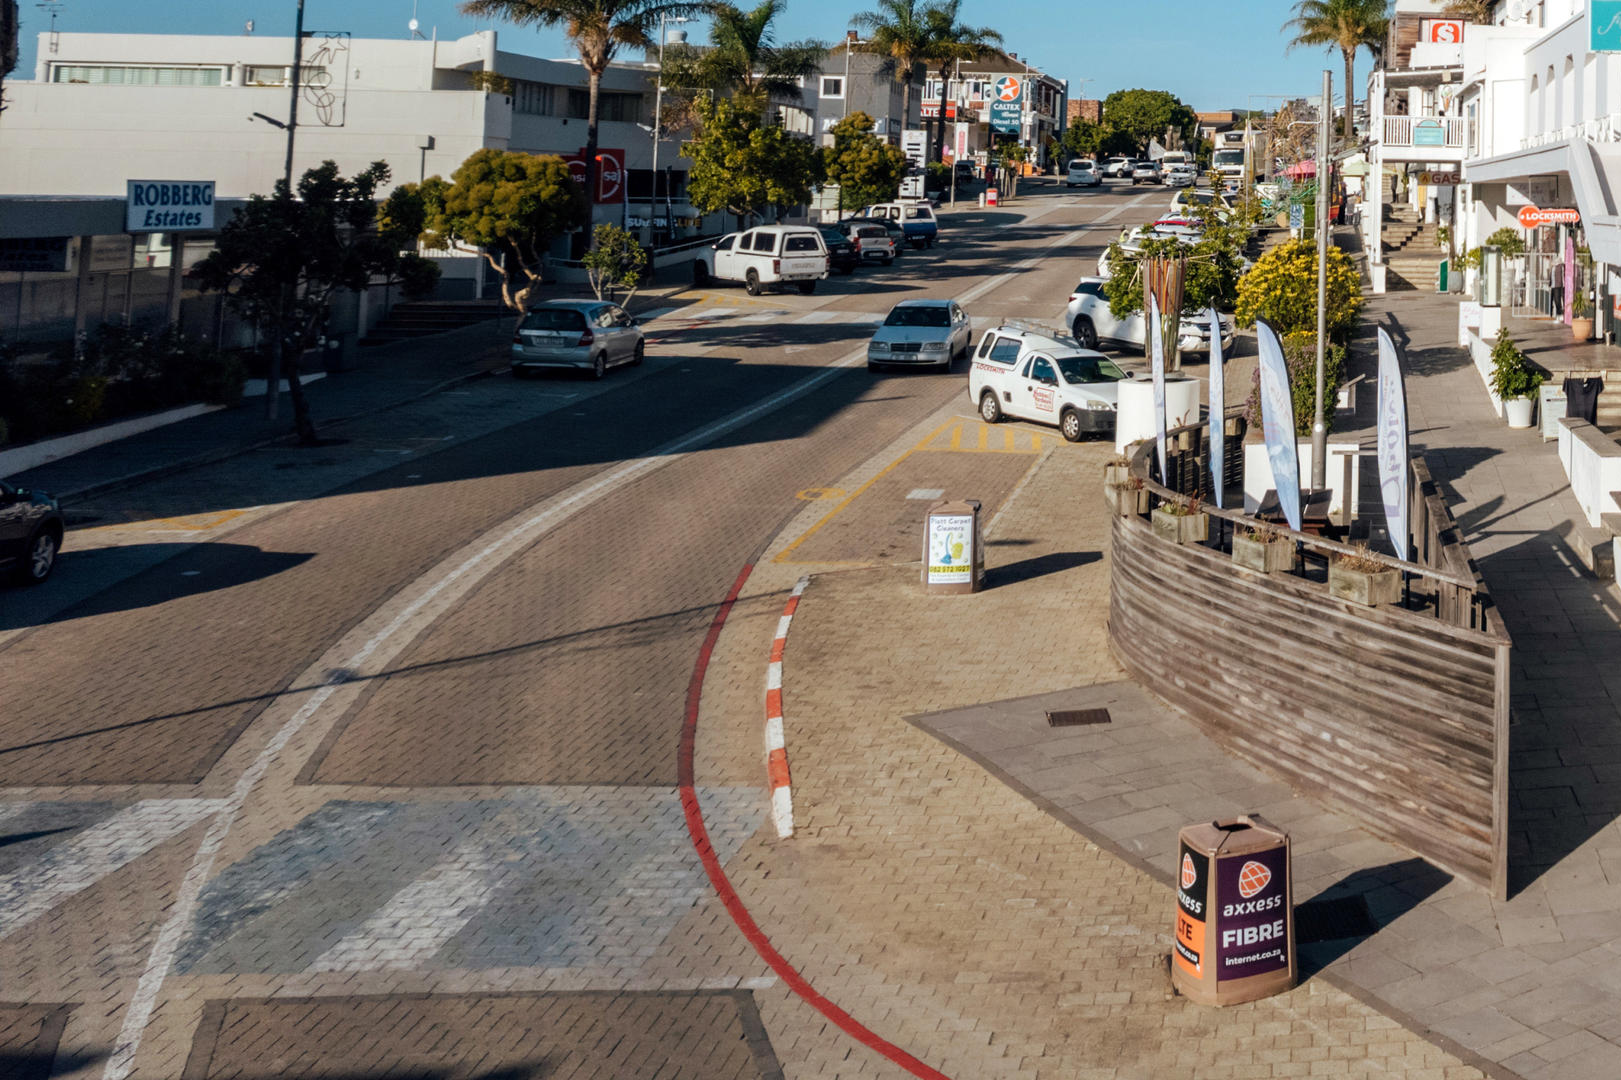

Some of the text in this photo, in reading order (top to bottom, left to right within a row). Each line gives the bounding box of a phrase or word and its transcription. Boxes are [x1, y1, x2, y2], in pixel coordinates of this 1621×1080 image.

[920, 107, 941, 118] ALTE
[993, 103, 1020, 111] CALTEX
[1431, 174, 1461, 185] GAS
[133, 184, 212, 206] ROBBERG
[144, 210, 201, 227] Estates
[1526, 212, 1576, 221] LOCKSMITH
[976, 363, 1005, 374] LOCKSMITH
[1223, 894, 1282, 918] axxess
[1223, 919, 1284, 948] FIBRE
[1225, 948, 1282, 966] internet.co.za
